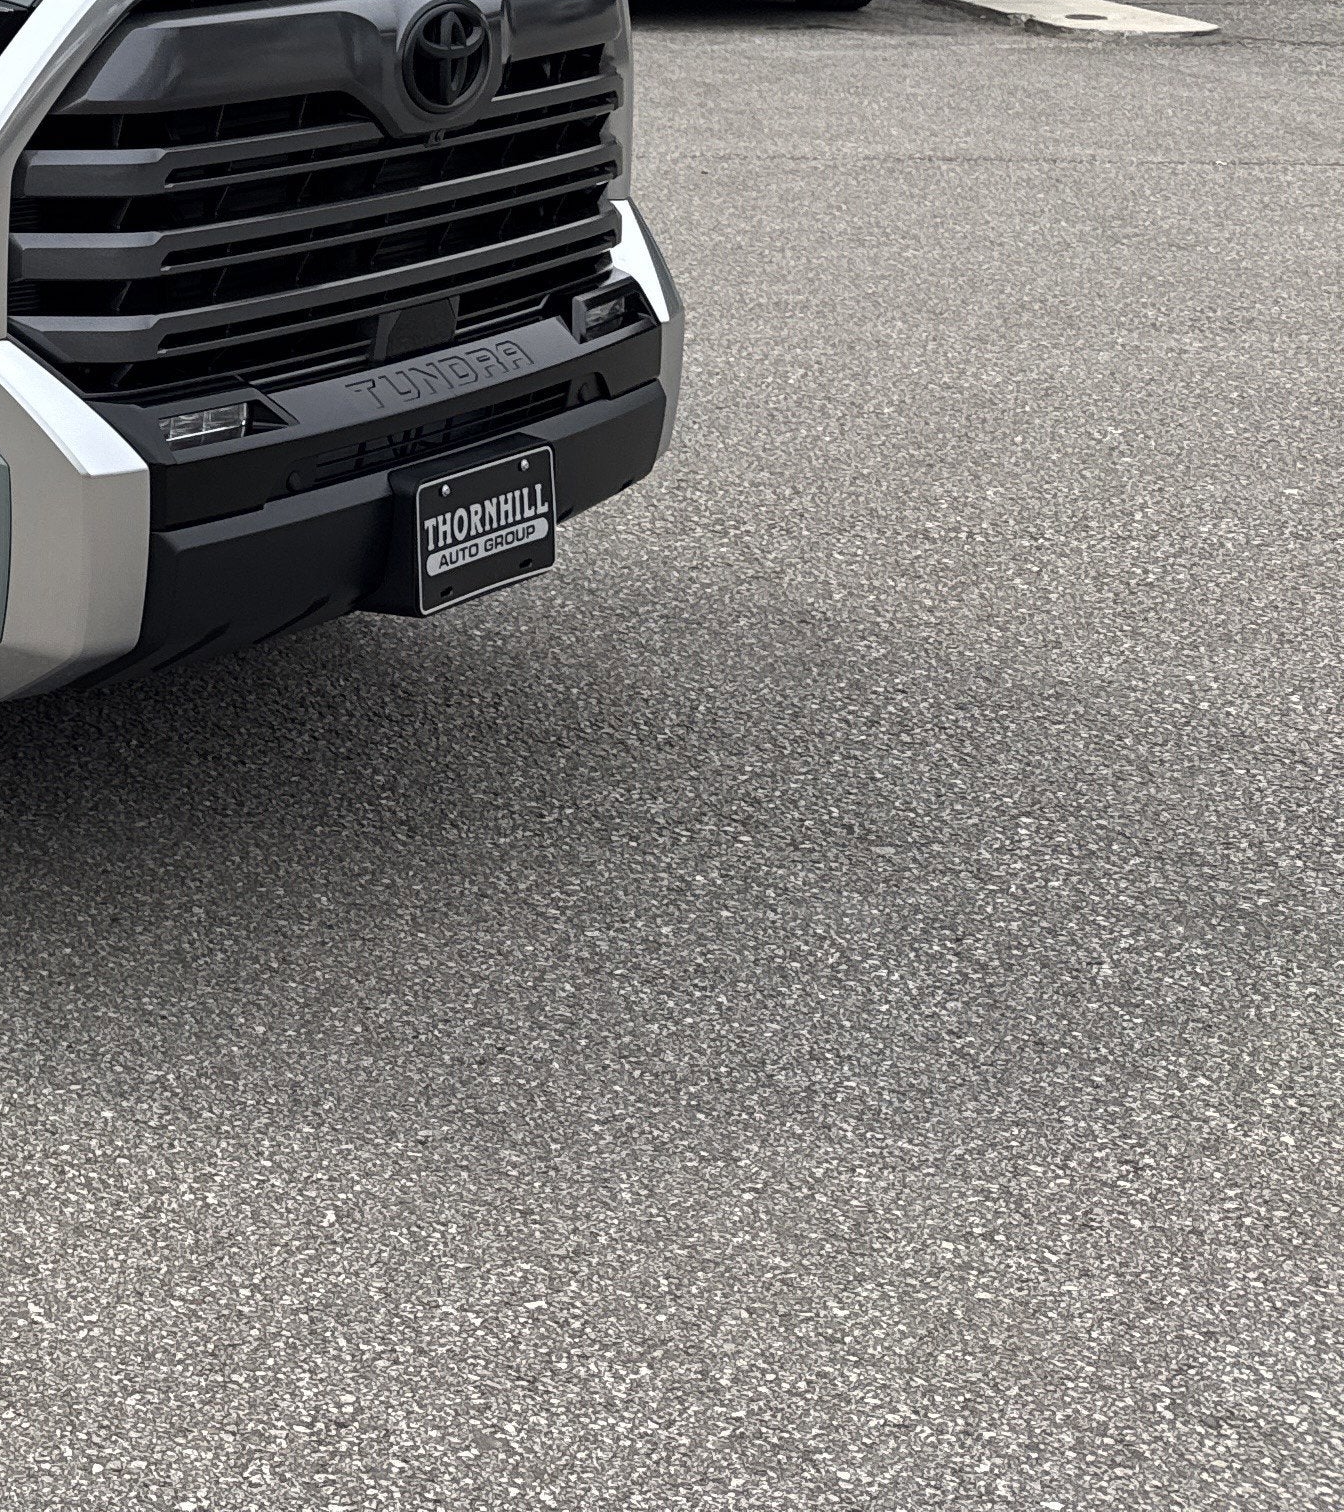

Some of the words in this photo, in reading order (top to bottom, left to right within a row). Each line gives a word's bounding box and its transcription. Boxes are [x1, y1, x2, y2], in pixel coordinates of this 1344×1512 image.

[344, 340, 537, 409] TUNDRA
[423, 483, 549, 552] THORNHILL
[438, 542, 479, 570] AUTO
[484, 523, 536, 553] GROUP
